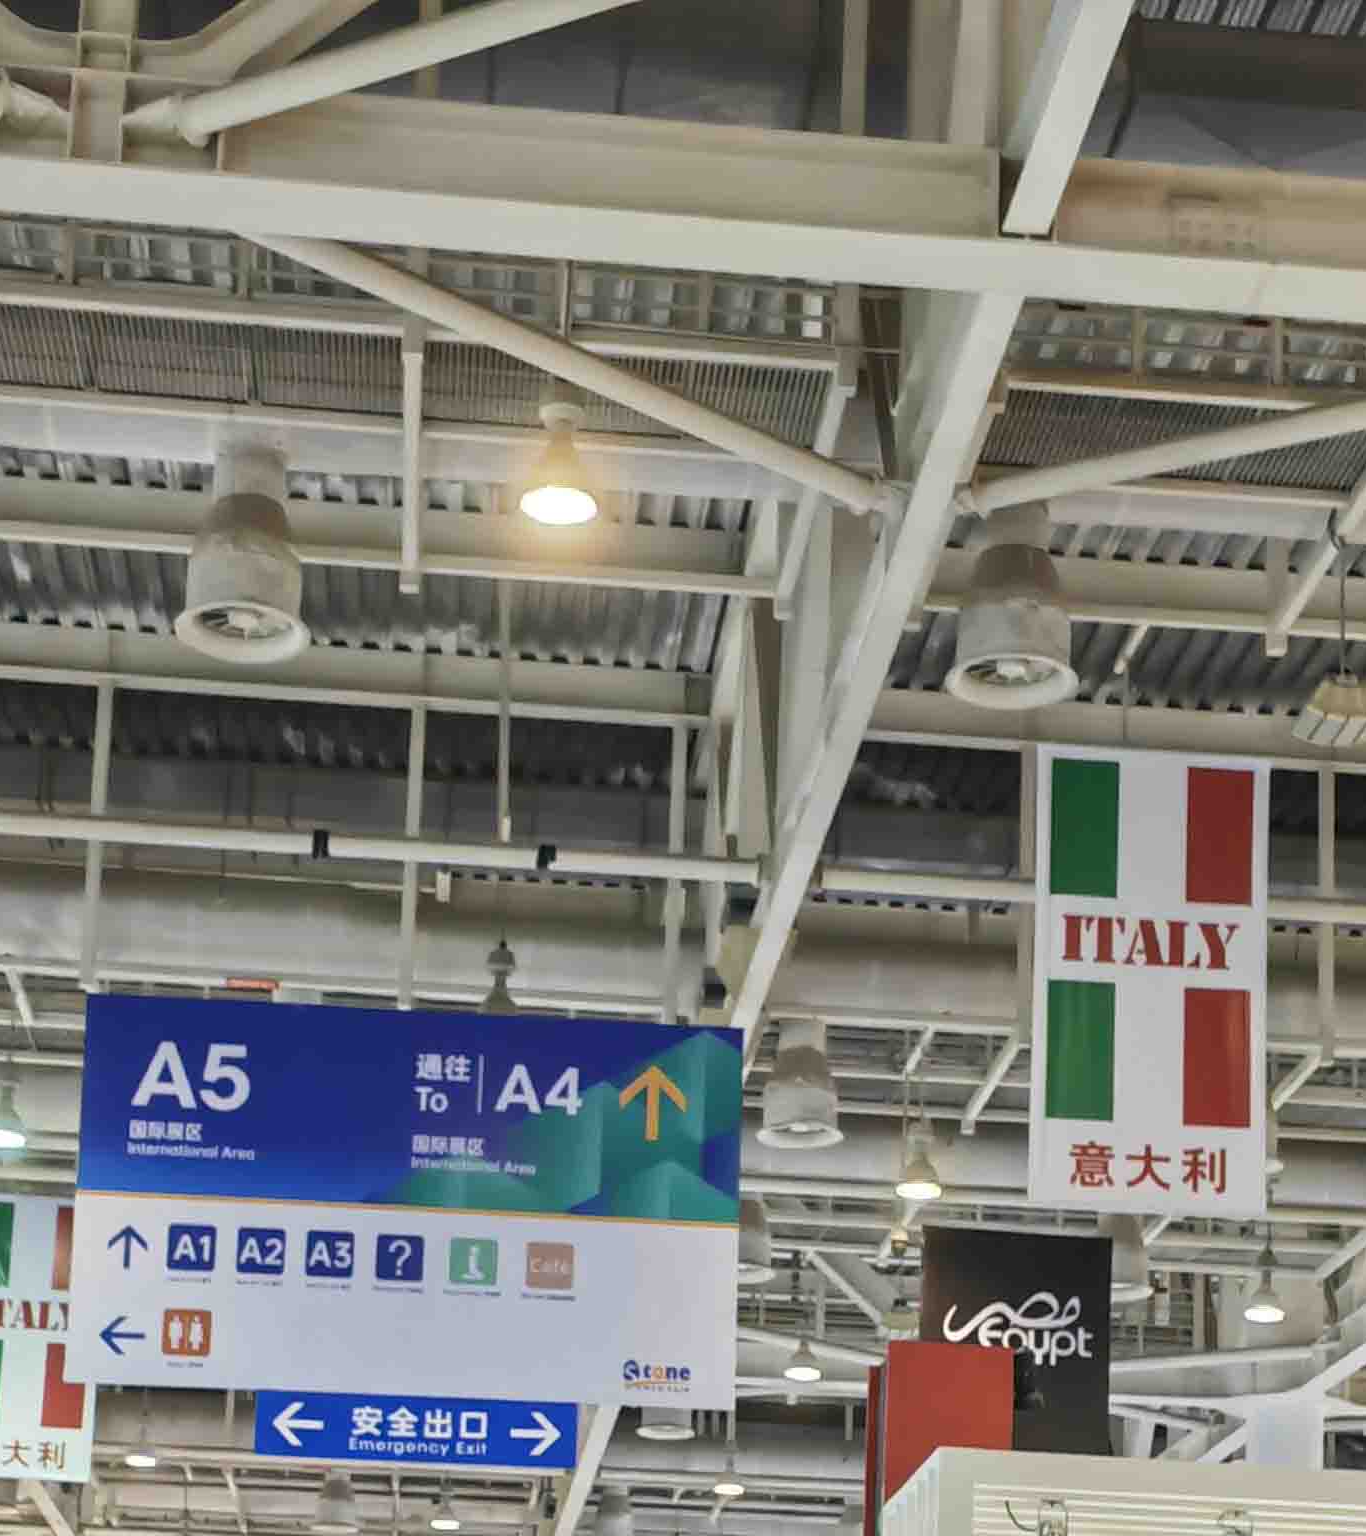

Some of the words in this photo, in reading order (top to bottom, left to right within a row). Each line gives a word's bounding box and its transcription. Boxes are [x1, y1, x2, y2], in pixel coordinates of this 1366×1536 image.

[1061, 914, 1240, 970] ITALY
[131, 1040, 251, 1112] A5
[415, 1053, 472, 1083] 通往
[415, 1086, 449, 1113] To
[494, 1064, 584, 1116] A4
[127, 1142, 219, 1159] International
[221, 1147, 256, 1161] Area
[1069, 1142, 1227, 1195] 意大利
[173, 1233, 212, 1264] A1
[239, 1237, 283, 1266] A2
[309, 1240, 352, 1269] A3
[350, 1405, 489, 1439] 安全出口
[348, 1437, 450, 1456] Emergency
[455, 1440, 488, 1457] Exit
